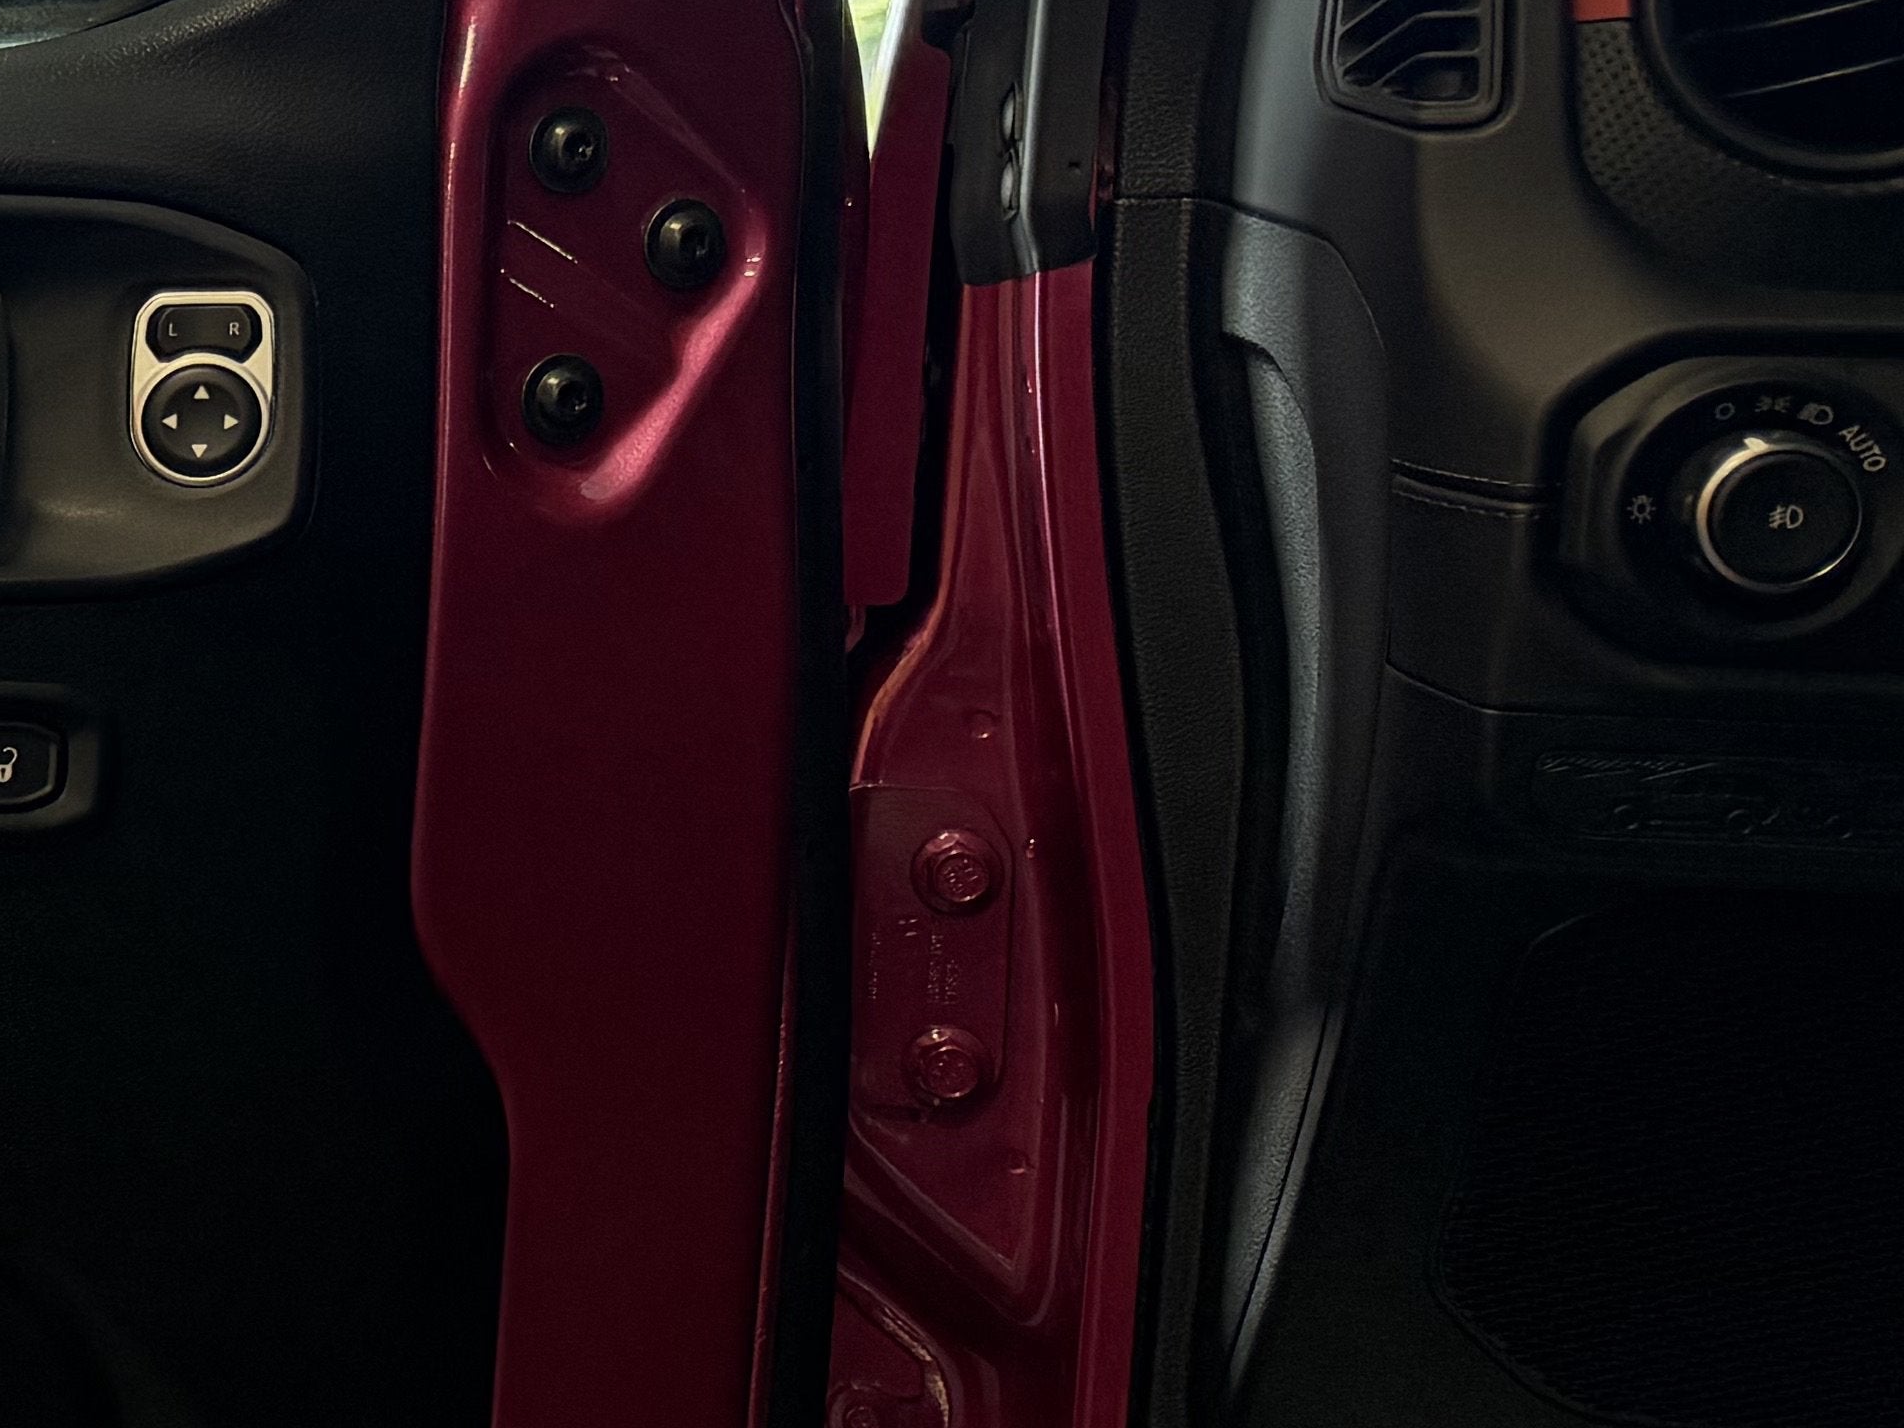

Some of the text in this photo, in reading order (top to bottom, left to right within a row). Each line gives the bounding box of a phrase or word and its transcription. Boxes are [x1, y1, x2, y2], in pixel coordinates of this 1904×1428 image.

[168, 322, 240, 336] L R
[1838, 425, 1887, 472] AUTO
